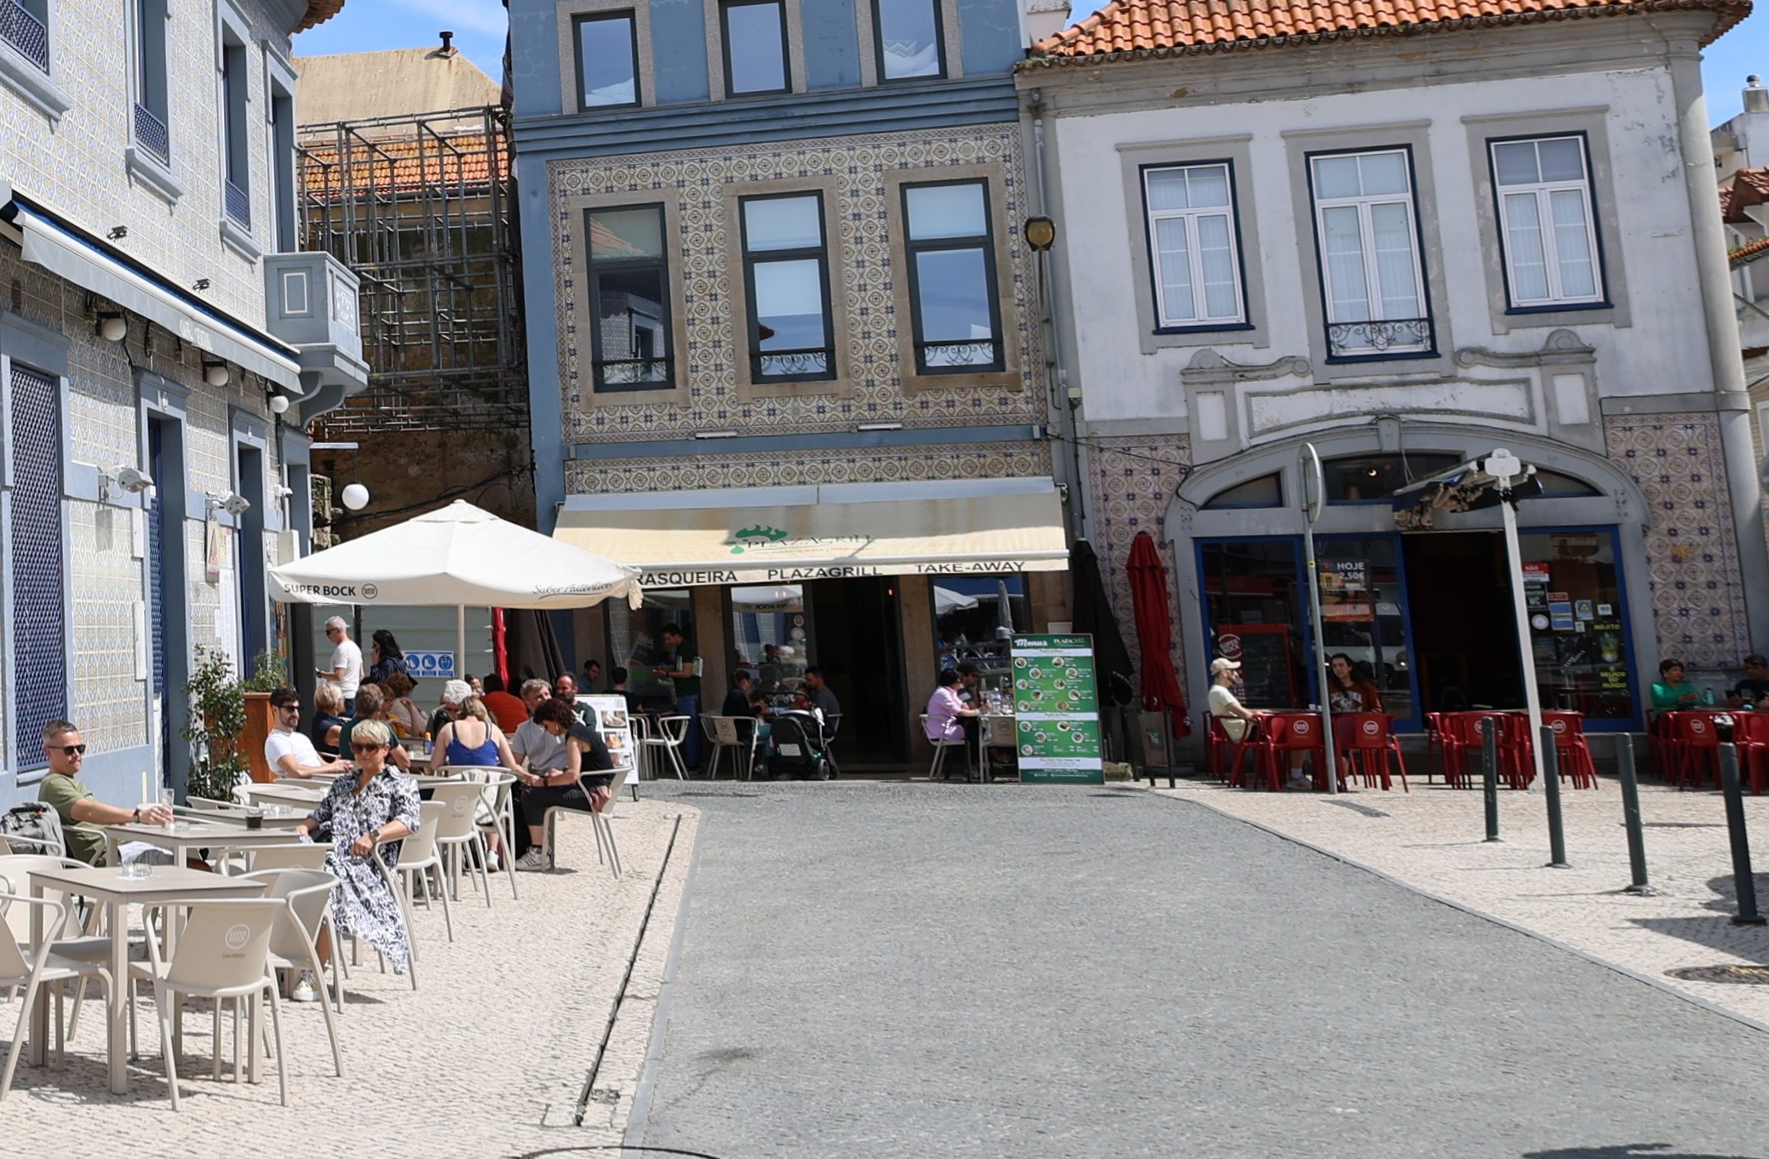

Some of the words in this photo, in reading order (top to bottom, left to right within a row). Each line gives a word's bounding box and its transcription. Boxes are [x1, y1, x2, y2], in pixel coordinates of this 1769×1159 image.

[767, 565, 885, 581] PLAZAGRILL
[913, 561, 1026, 573] TAKE-AWAY
[1336, 562, 1366, 571] HOJE
[284, 583, 321, 595] SUPER
[322, 585, 357, 597] BOCK
[1014, 638, 1049, 647] Menus
